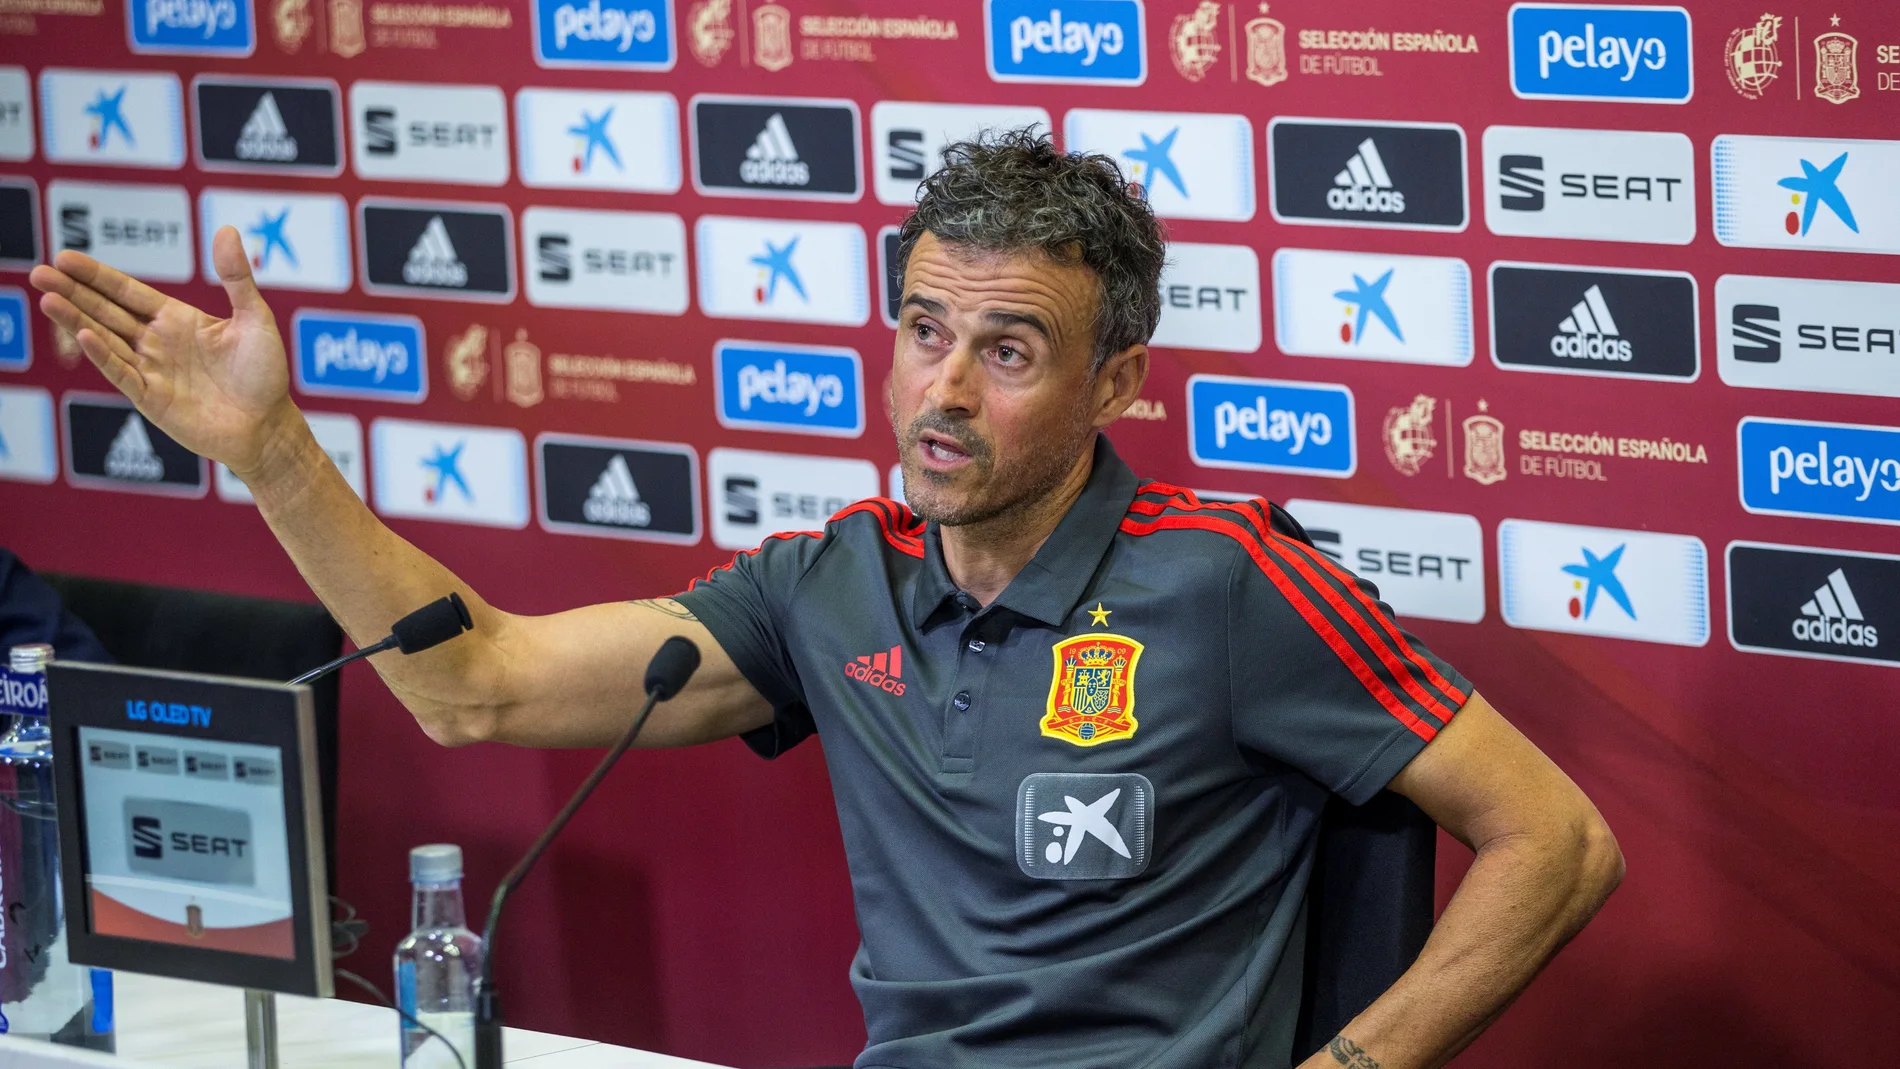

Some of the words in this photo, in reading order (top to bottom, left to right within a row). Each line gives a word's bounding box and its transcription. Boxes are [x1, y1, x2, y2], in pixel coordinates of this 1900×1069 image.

[554, 0, 656, 51] pelayo
[1011, 9, 1124, 66] pelayo
[1299, 27, 1390, 51] SELECCIÓN
[1391, 29, 1479, 53] ESPAÑOLA
[1300, 54, 1322, 75] DE
[1323, 52, 1384, 77] FÚTBOL
[1539, 23, 1667, 82] pelayo
[1876, 45, 1900, 64] SE
[408, 121, 499, 148] SEAT
[740, 158, 810, 186] adidas
[1326, 185, 1405, 214] adidas
[1560, 173, 1682, 202] SEAT
[100, 218, 182, 248] SEAT
[403, 259, 468, 287] adidas
[582, 247, 676, 276] SEAT
[1158, 284, 1247, 312] EAT
[313, 328, 409, 384] pelayo
[1550, 333, 1633, 362] adidas
[738, 359, 844, 416] pelayo
[1214, 396, 1332, 455] pelayo
[1518, 429, 1615, 456] SELECCIÓN
[1617, 437, 1708, 464] ESPAÑOLA
[1519, 455, 1543, 476] DE
[1544, 455, 1608, 482] FÚTBOL
[1769, 440, 1900, 502] pelayo
[583, 499, 651, 528] adidas
[1357, 547, 1472, 583] SEAT
[1791, 617, 1879, 648] adidas
[844, 660, 906, 697] adidas
[126, 700, 148, 721] LG
[149, 702, 190, 726] OLED
[190, 705, 212, 728] TV
[170, 832, 248, 858] SEAT
